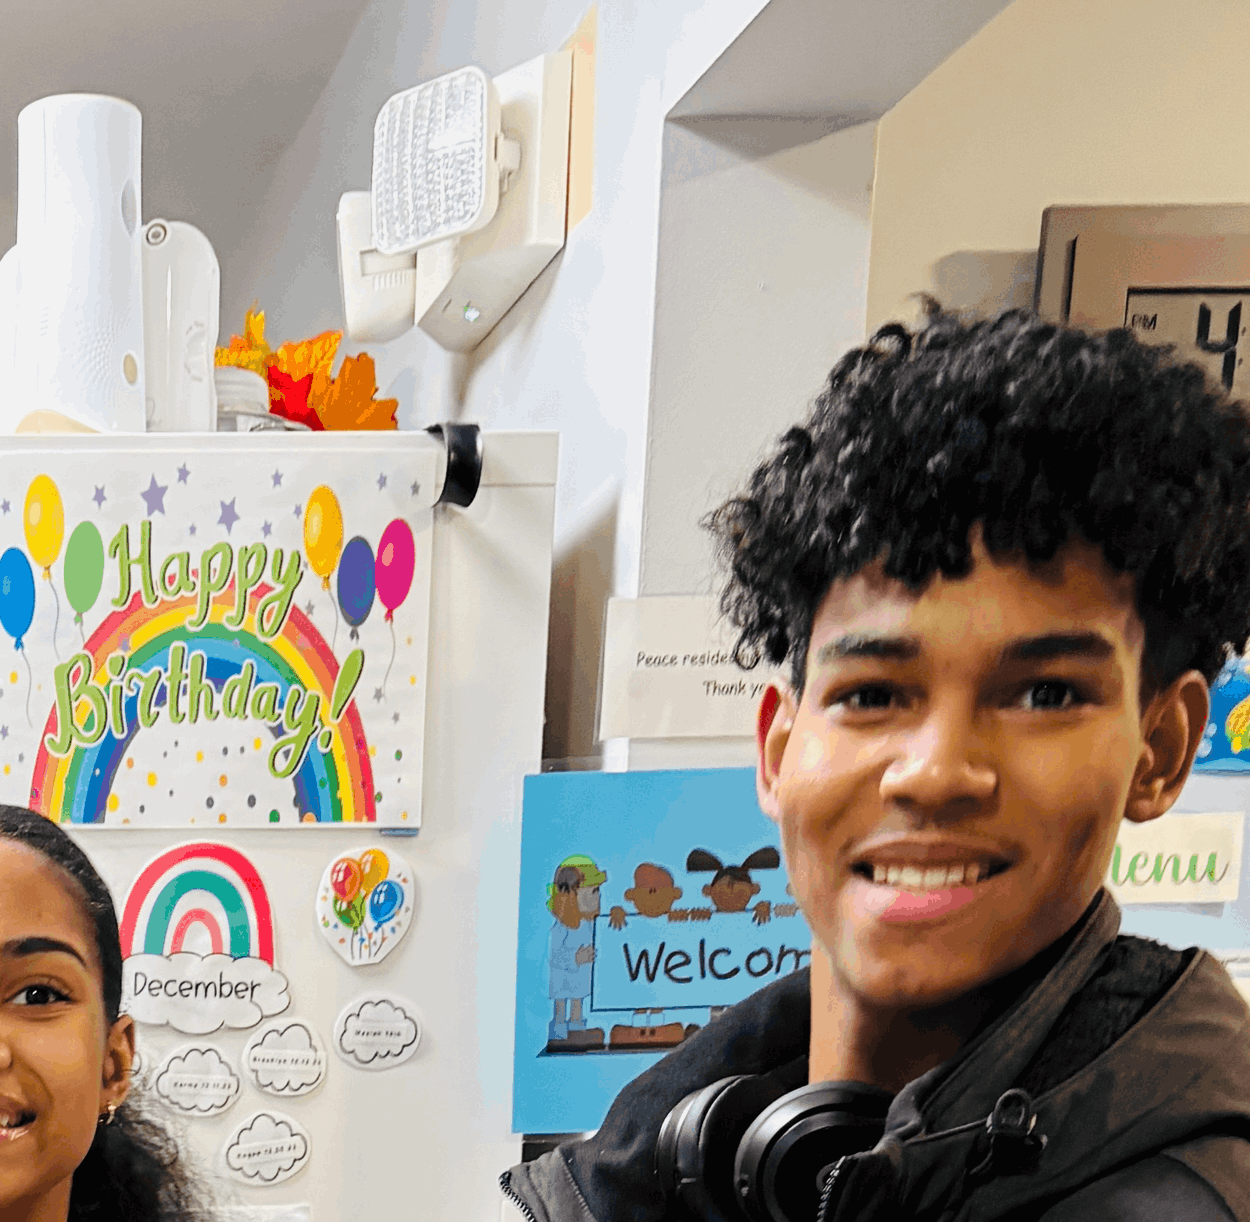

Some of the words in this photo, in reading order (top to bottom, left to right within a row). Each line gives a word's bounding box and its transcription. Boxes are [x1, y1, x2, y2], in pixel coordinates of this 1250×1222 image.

[1131, 313, 1158, 331] PM
[108, 520, 304, 638] Happy
[636, 650, 678, 668] Peace
[682, 650, 734, 667] reside
[703, 679, 747, 697] Thank
[46, 642, 366, 779] Birthday!
[133, 970, 262, 1002] December
